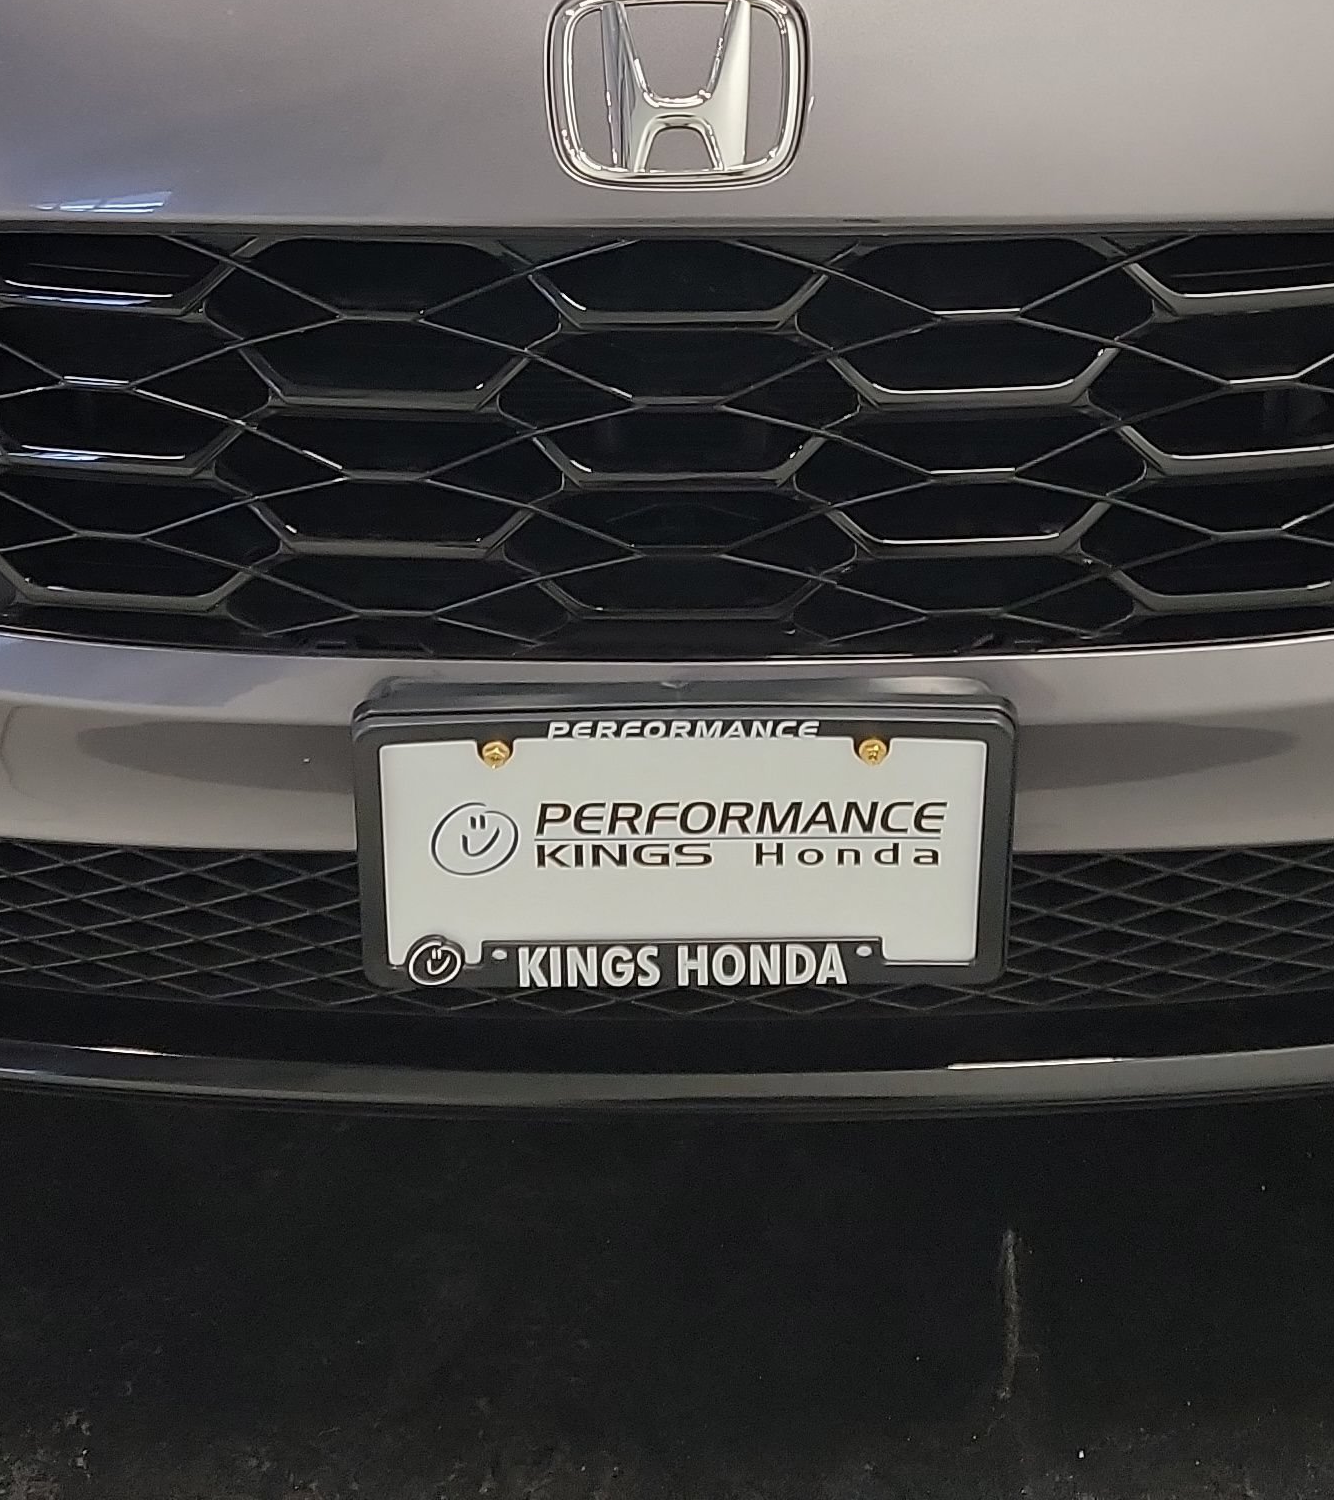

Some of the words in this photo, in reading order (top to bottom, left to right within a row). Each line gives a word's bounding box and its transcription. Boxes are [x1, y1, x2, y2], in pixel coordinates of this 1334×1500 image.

[547, 719, 820, 740] PERFORMANCE
[536, 801, 948, 836] PERFORMANCE
[536, 843, 713, 869] KINGS
[754, 841, 942, 867] Honda
[517, 945, 661, 988] KINGS
[676, 942, 849, 987] HONDA
